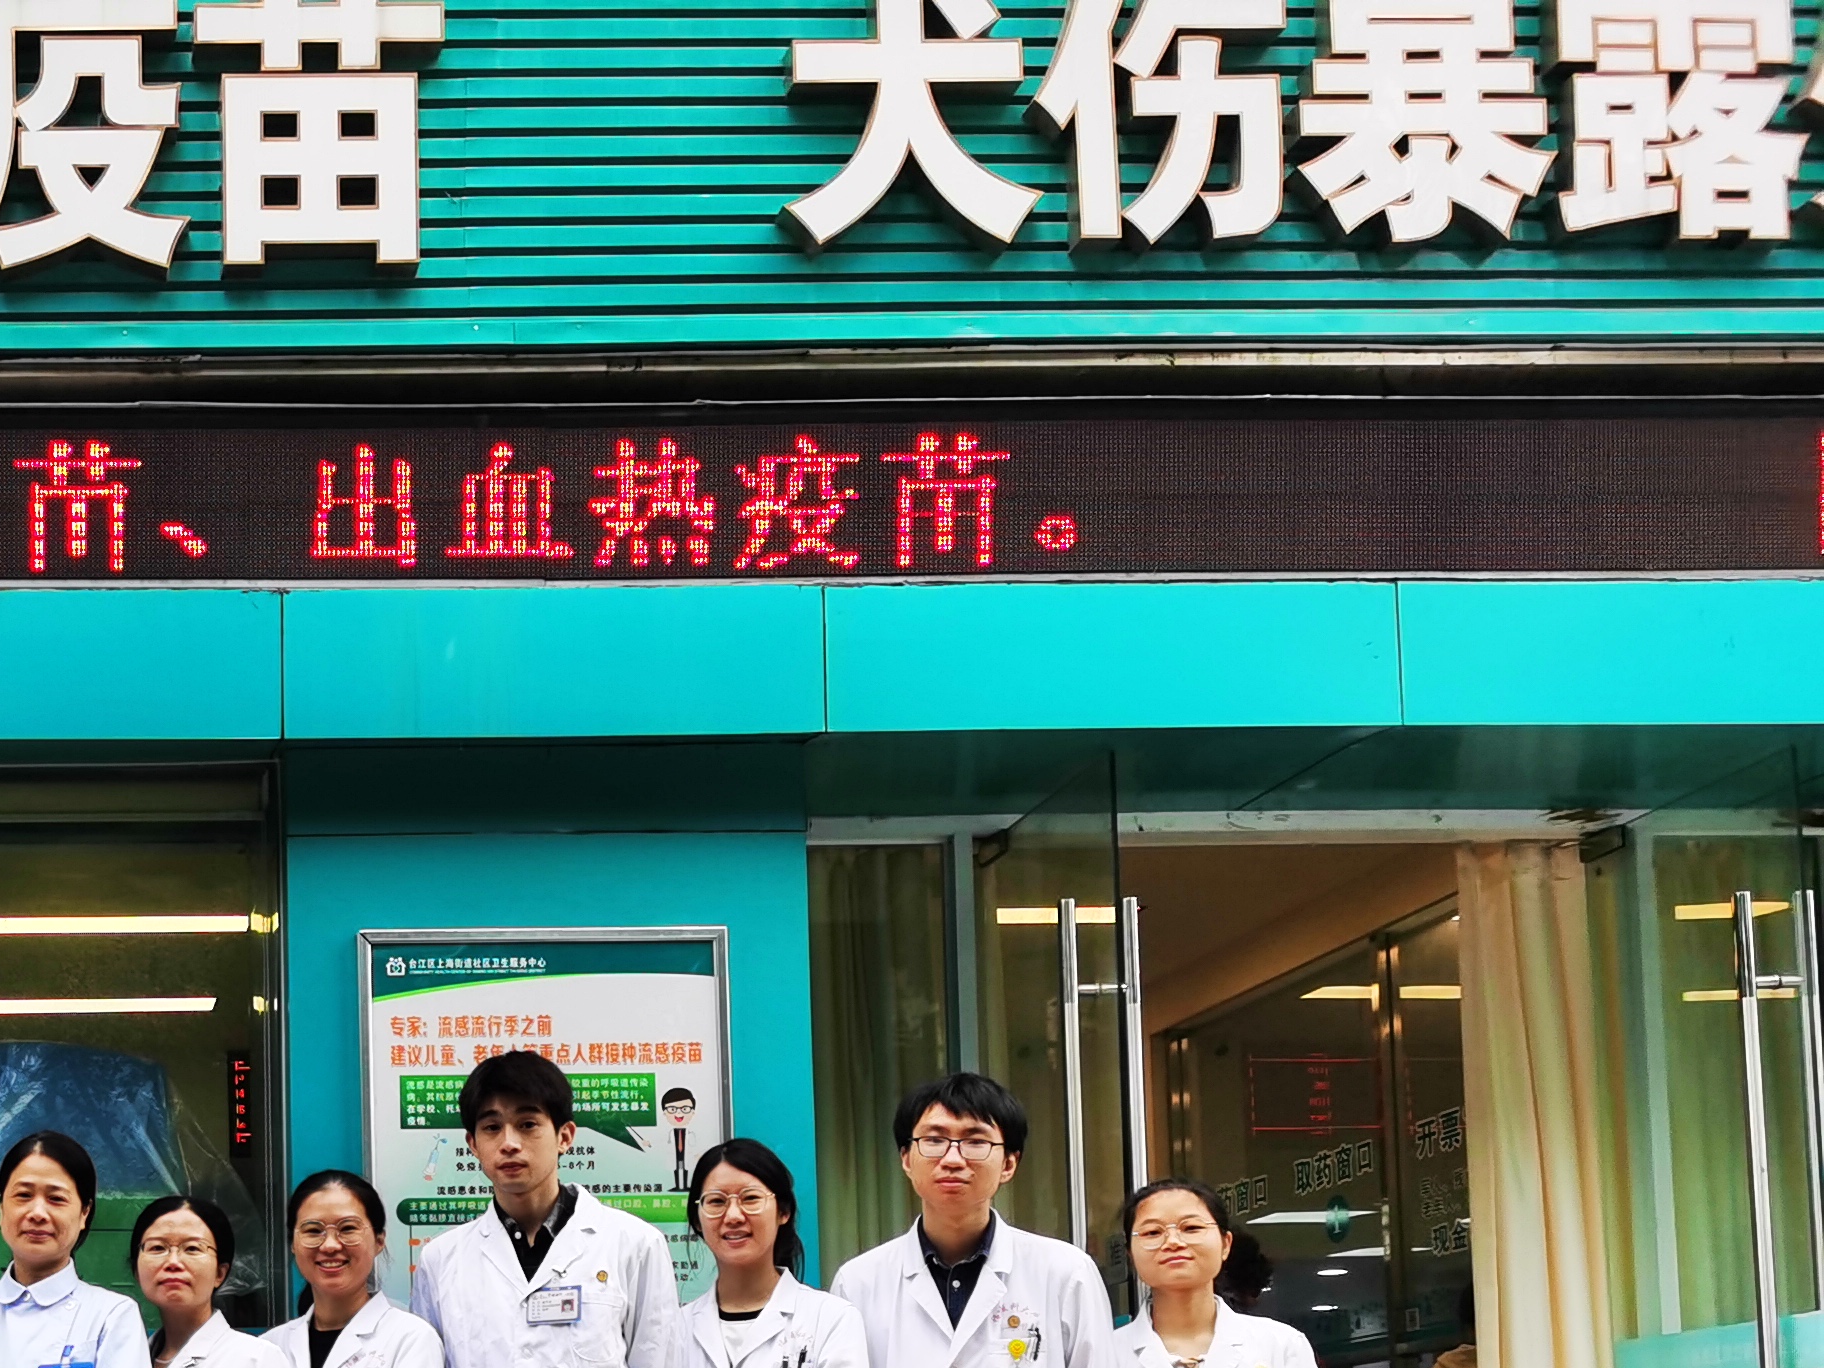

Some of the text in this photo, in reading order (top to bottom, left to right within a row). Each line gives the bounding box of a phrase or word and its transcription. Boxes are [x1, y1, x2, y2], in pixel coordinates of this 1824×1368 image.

[784, 0, 1824, 244] 犬伤暴露
[1293, 1139, 1374, 1197] 取药窗口
